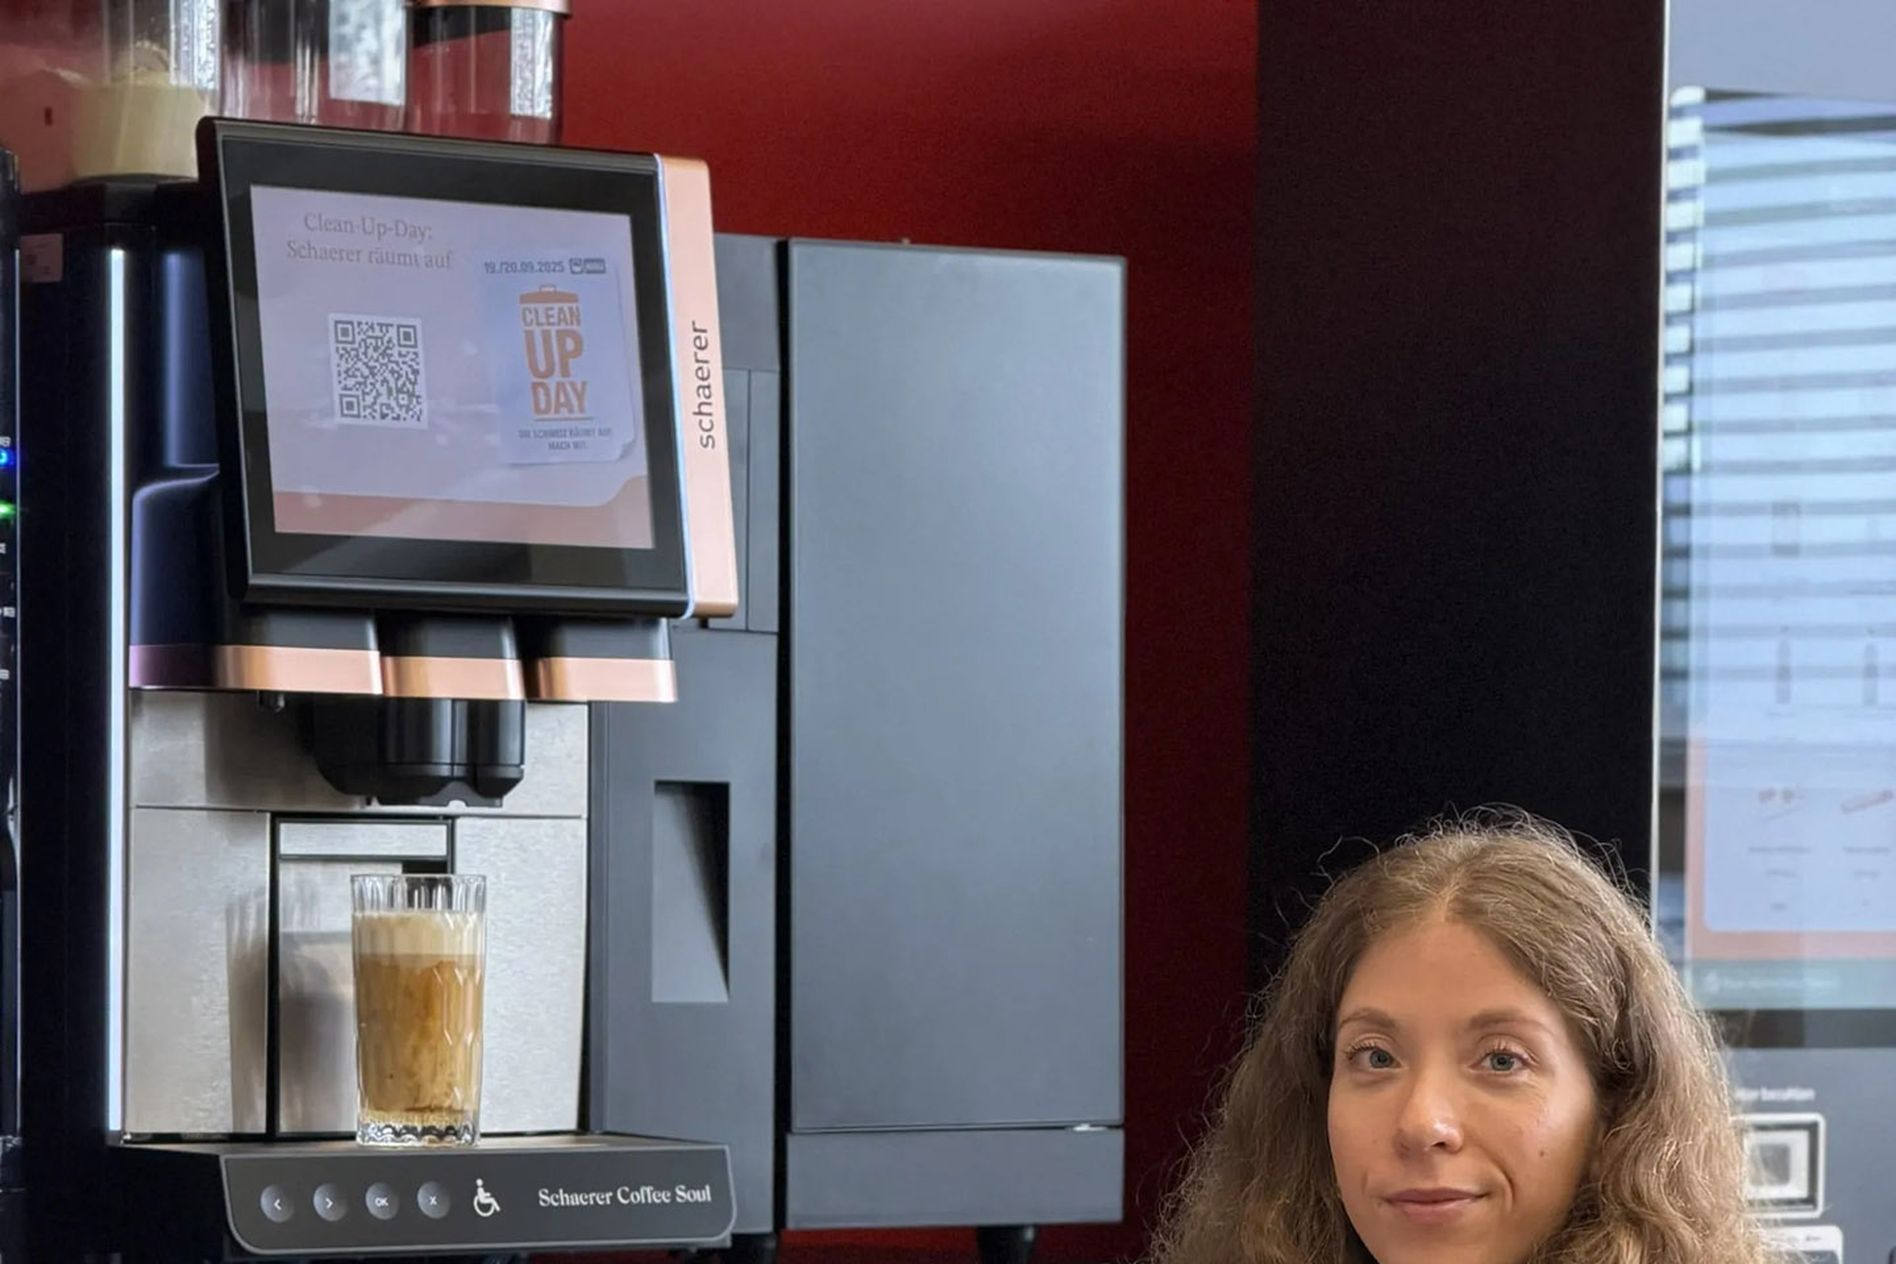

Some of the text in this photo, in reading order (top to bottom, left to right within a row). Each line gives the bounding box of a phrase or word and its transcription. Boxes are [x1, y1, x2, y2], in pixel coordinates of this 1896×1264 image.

[286, 240, 361, 263] Schaerer
[424, 250, 454, 269] auf
[521, 305, 581, 327] CLEAN
[523, 329, 584, 379] UP
[531, 380, 588, 416] DAY
[691, 319, 716, 450] schaerer
[538, 1183, 712, 1207] Schaerer Coffee Soul
